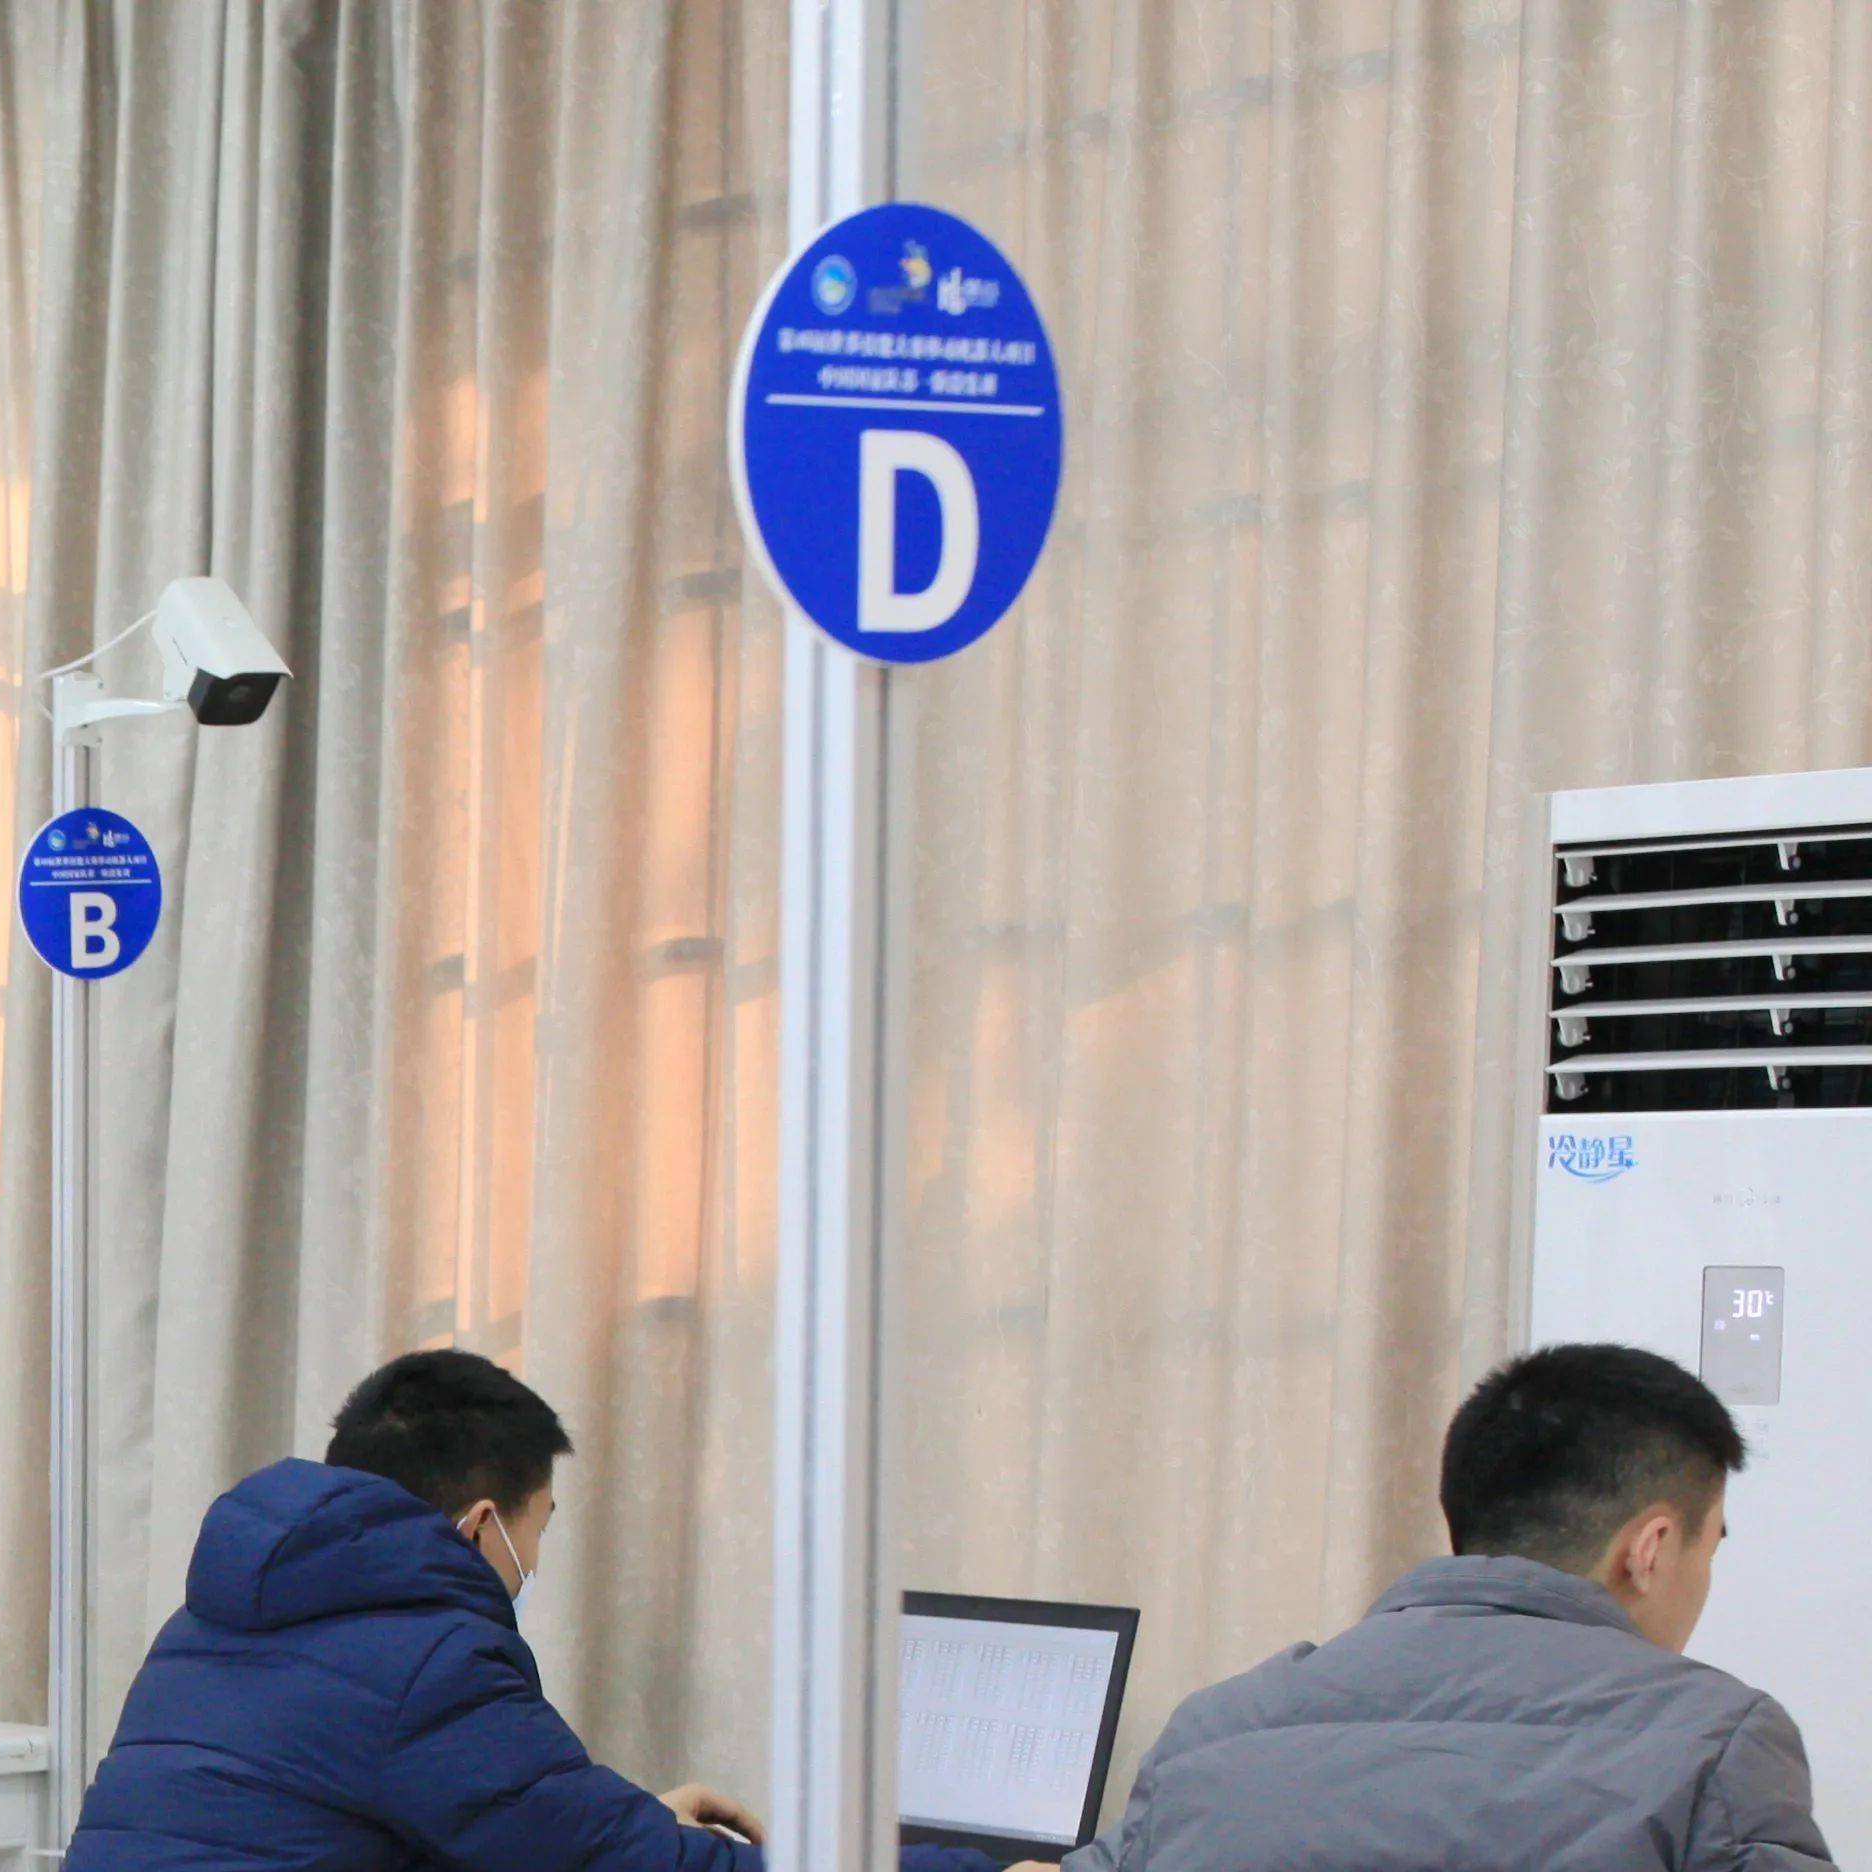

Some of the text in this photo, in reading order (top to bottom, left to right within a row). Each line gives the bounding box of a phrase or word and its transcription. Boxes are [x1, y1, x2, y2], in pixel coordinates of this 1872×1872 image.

[856, 427, 980, 634] D
[69, 891, 121, 969] B
[1548, 1134, 1638, 1171] 冷静星
